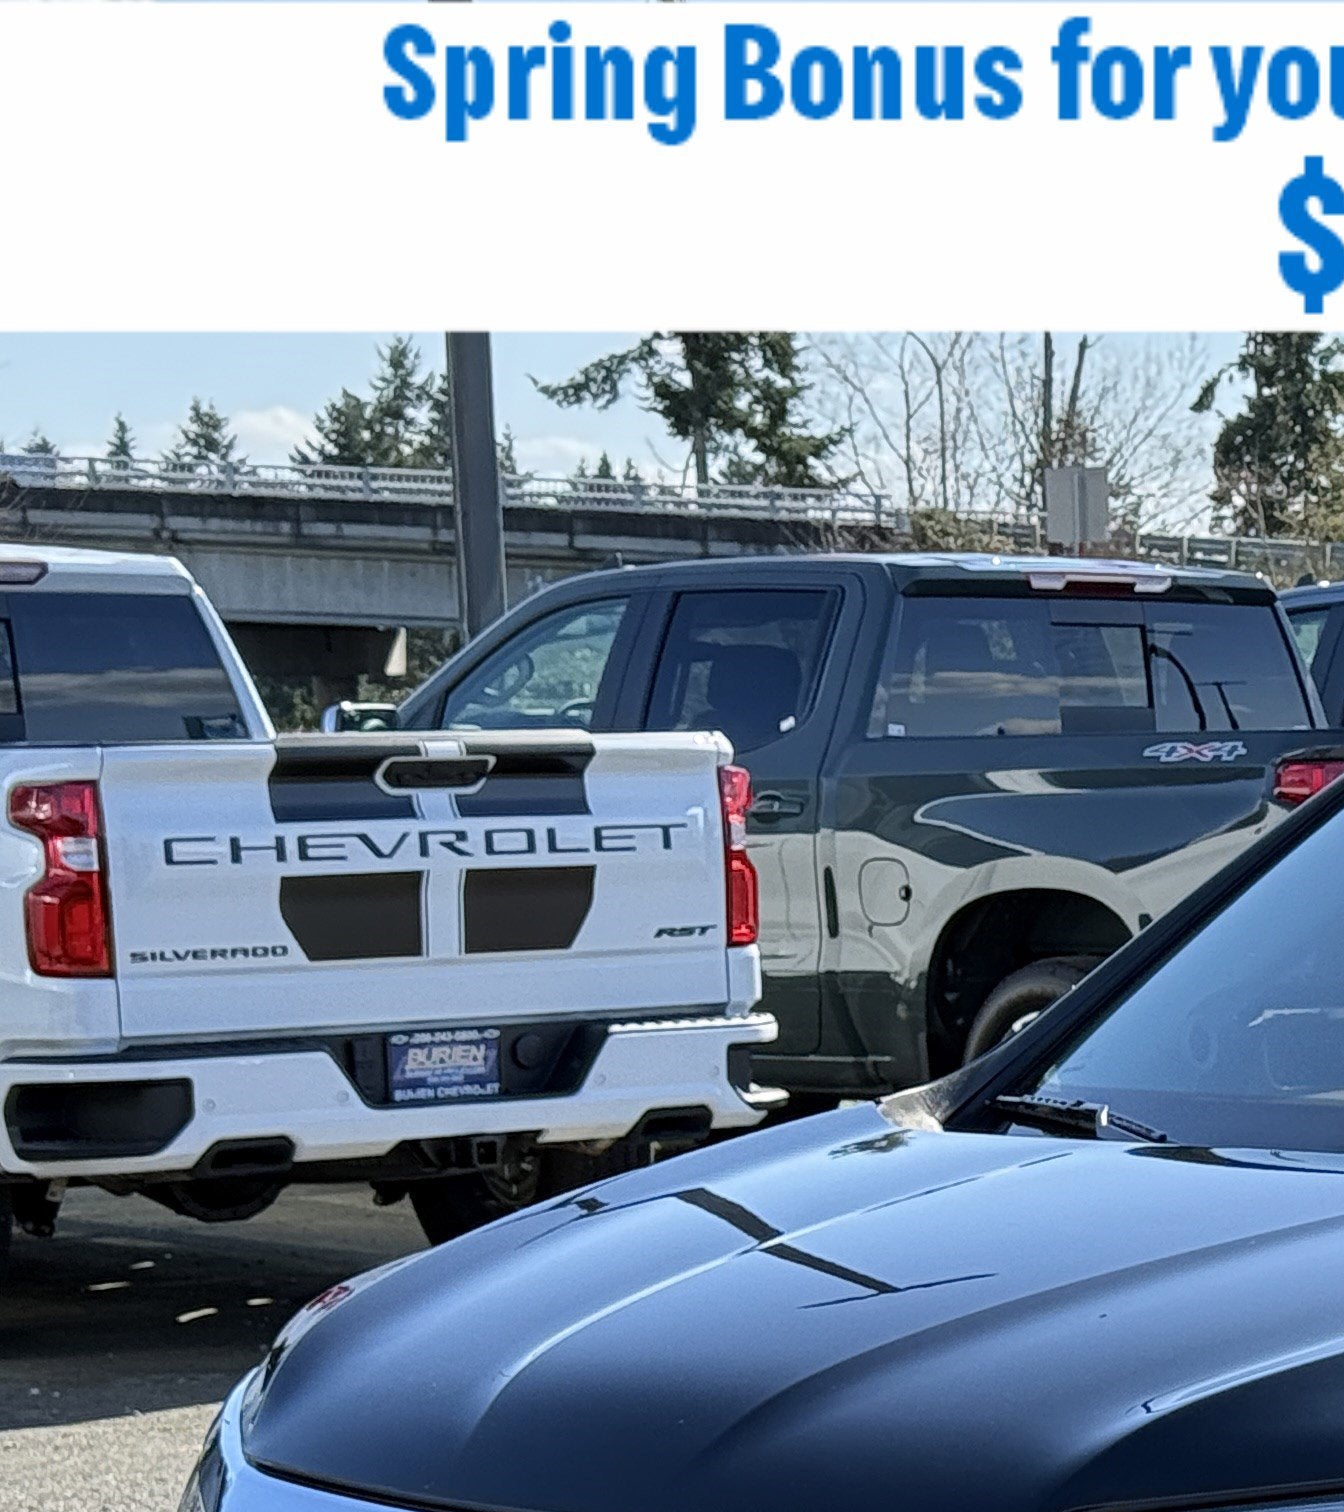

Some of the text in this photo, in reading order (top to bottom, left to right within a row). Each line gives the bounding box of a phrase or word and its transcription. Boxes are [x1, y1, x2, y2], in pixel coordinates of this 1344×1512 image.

[163, 822, 689, 867] CHEVROLET
[654, 924, 718, 939] RST
[130, 945, 289, 966] SILVERADO
[406, 1043, 486, 1068] BURIEN
